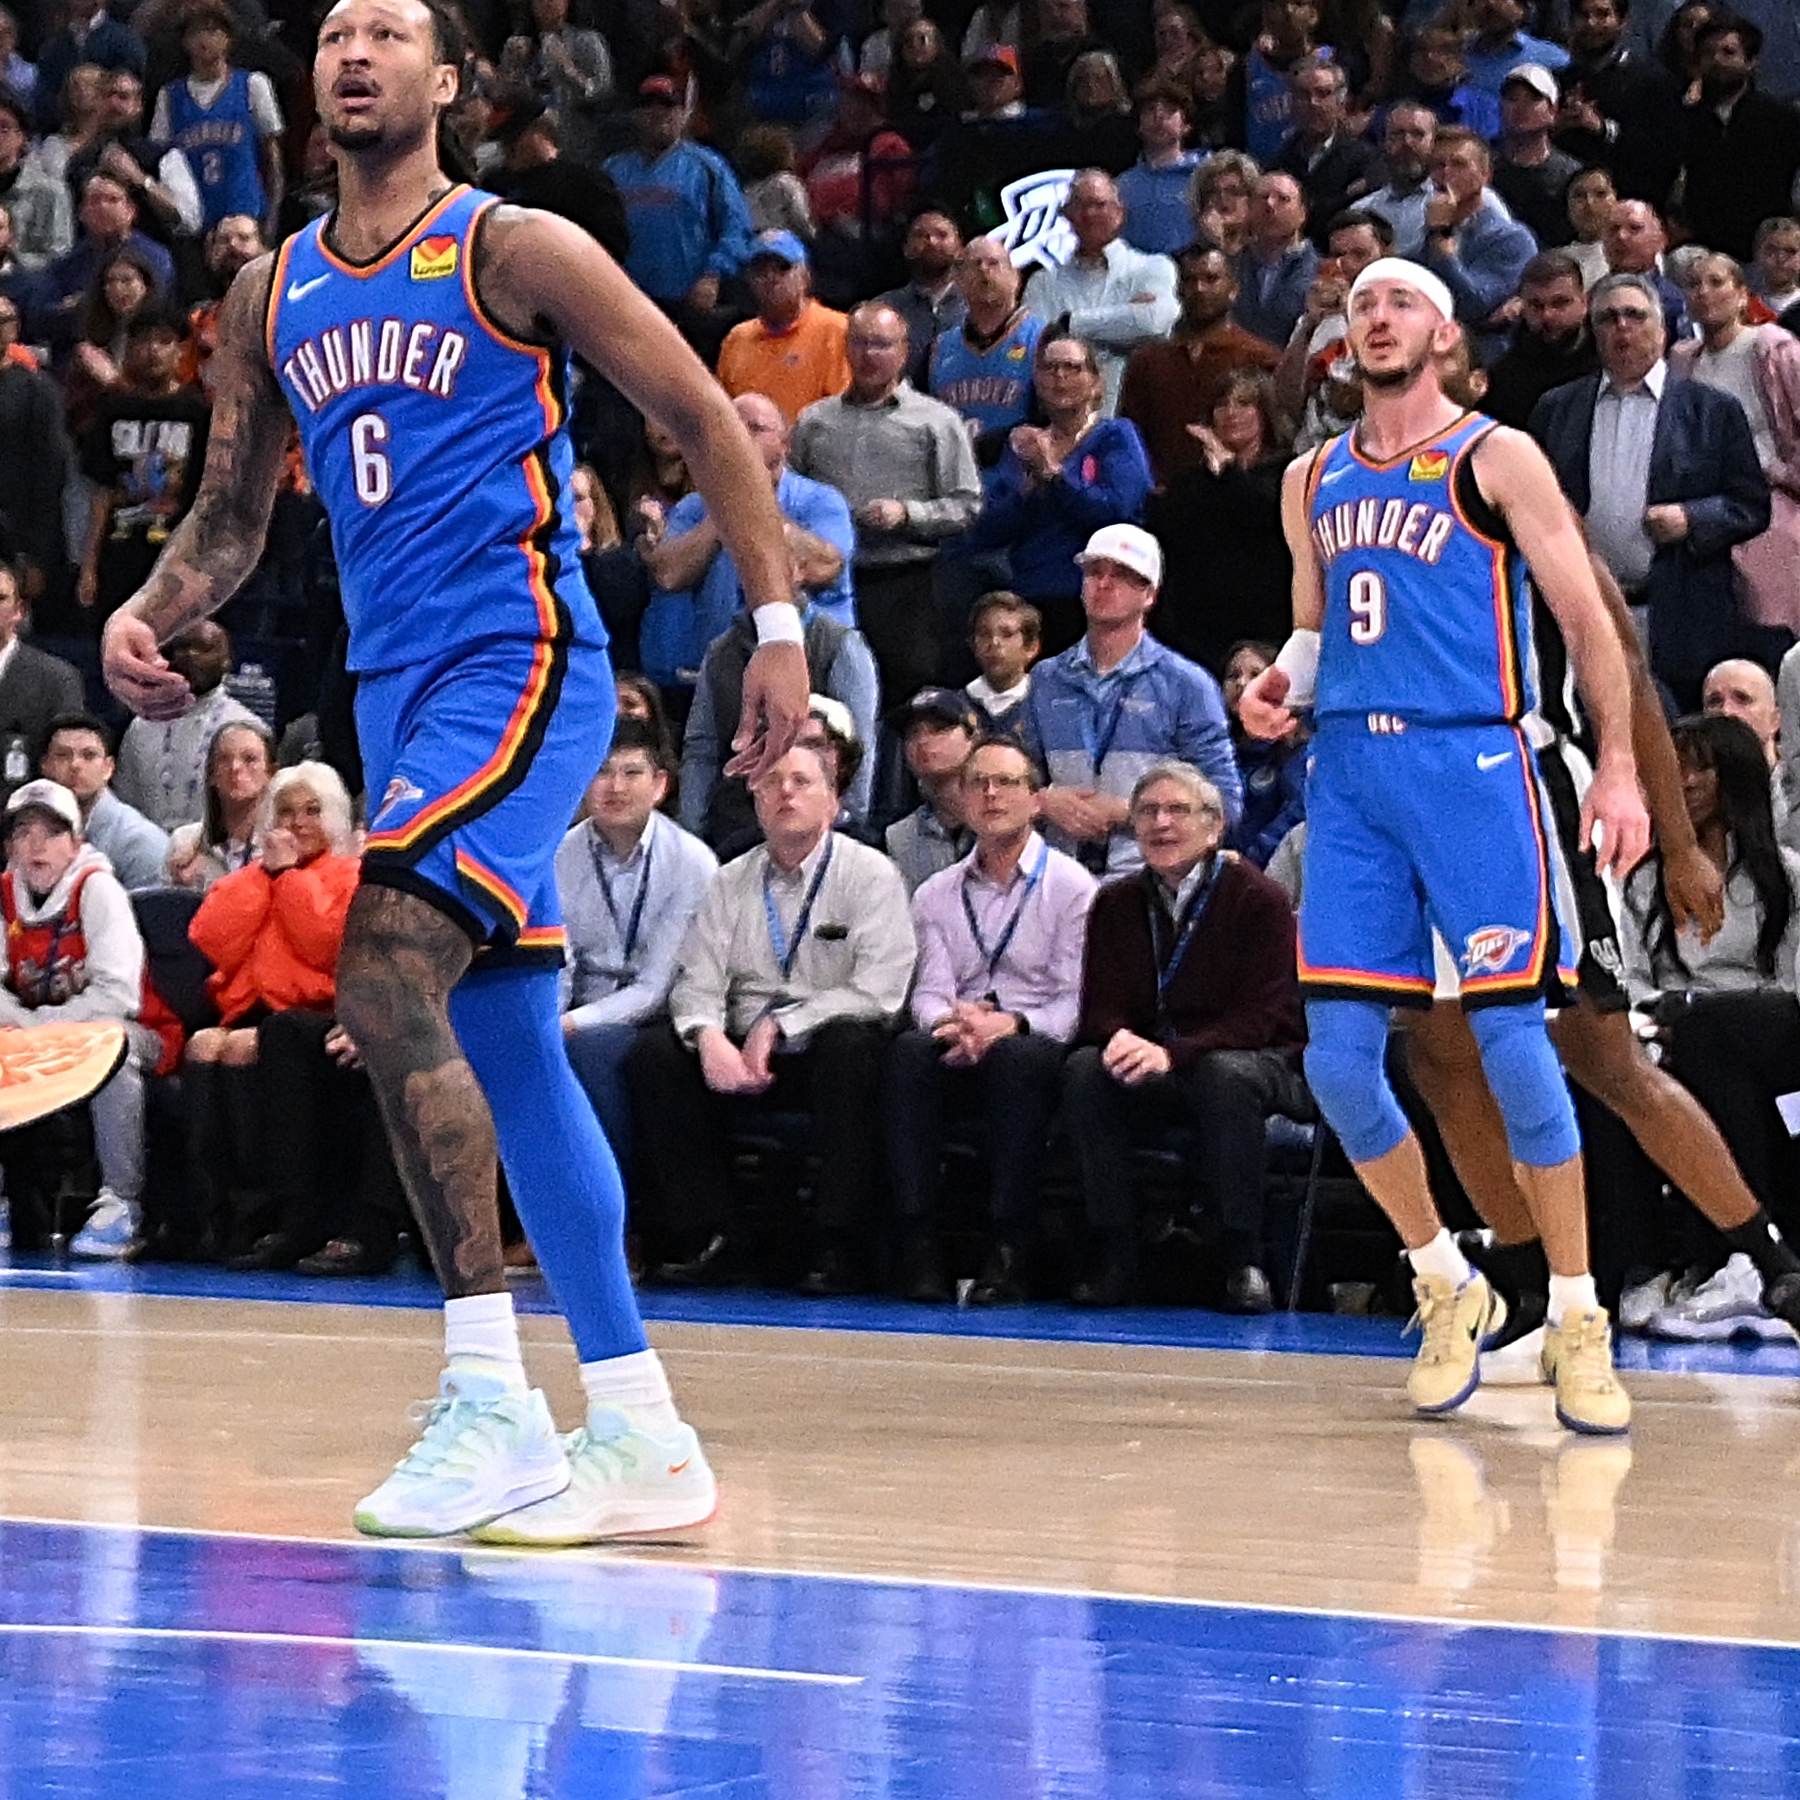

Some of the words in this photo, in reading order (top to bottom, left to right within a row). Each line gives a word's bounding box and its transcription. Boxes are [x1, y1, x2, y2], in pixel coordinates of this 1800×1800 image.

[283, 315, 468, 415] THUNDER
[350, 409, 396, 509] 6
[1312, 496, 1456, 566] HUNDER
[1349, 567, 1389, 646] 9
